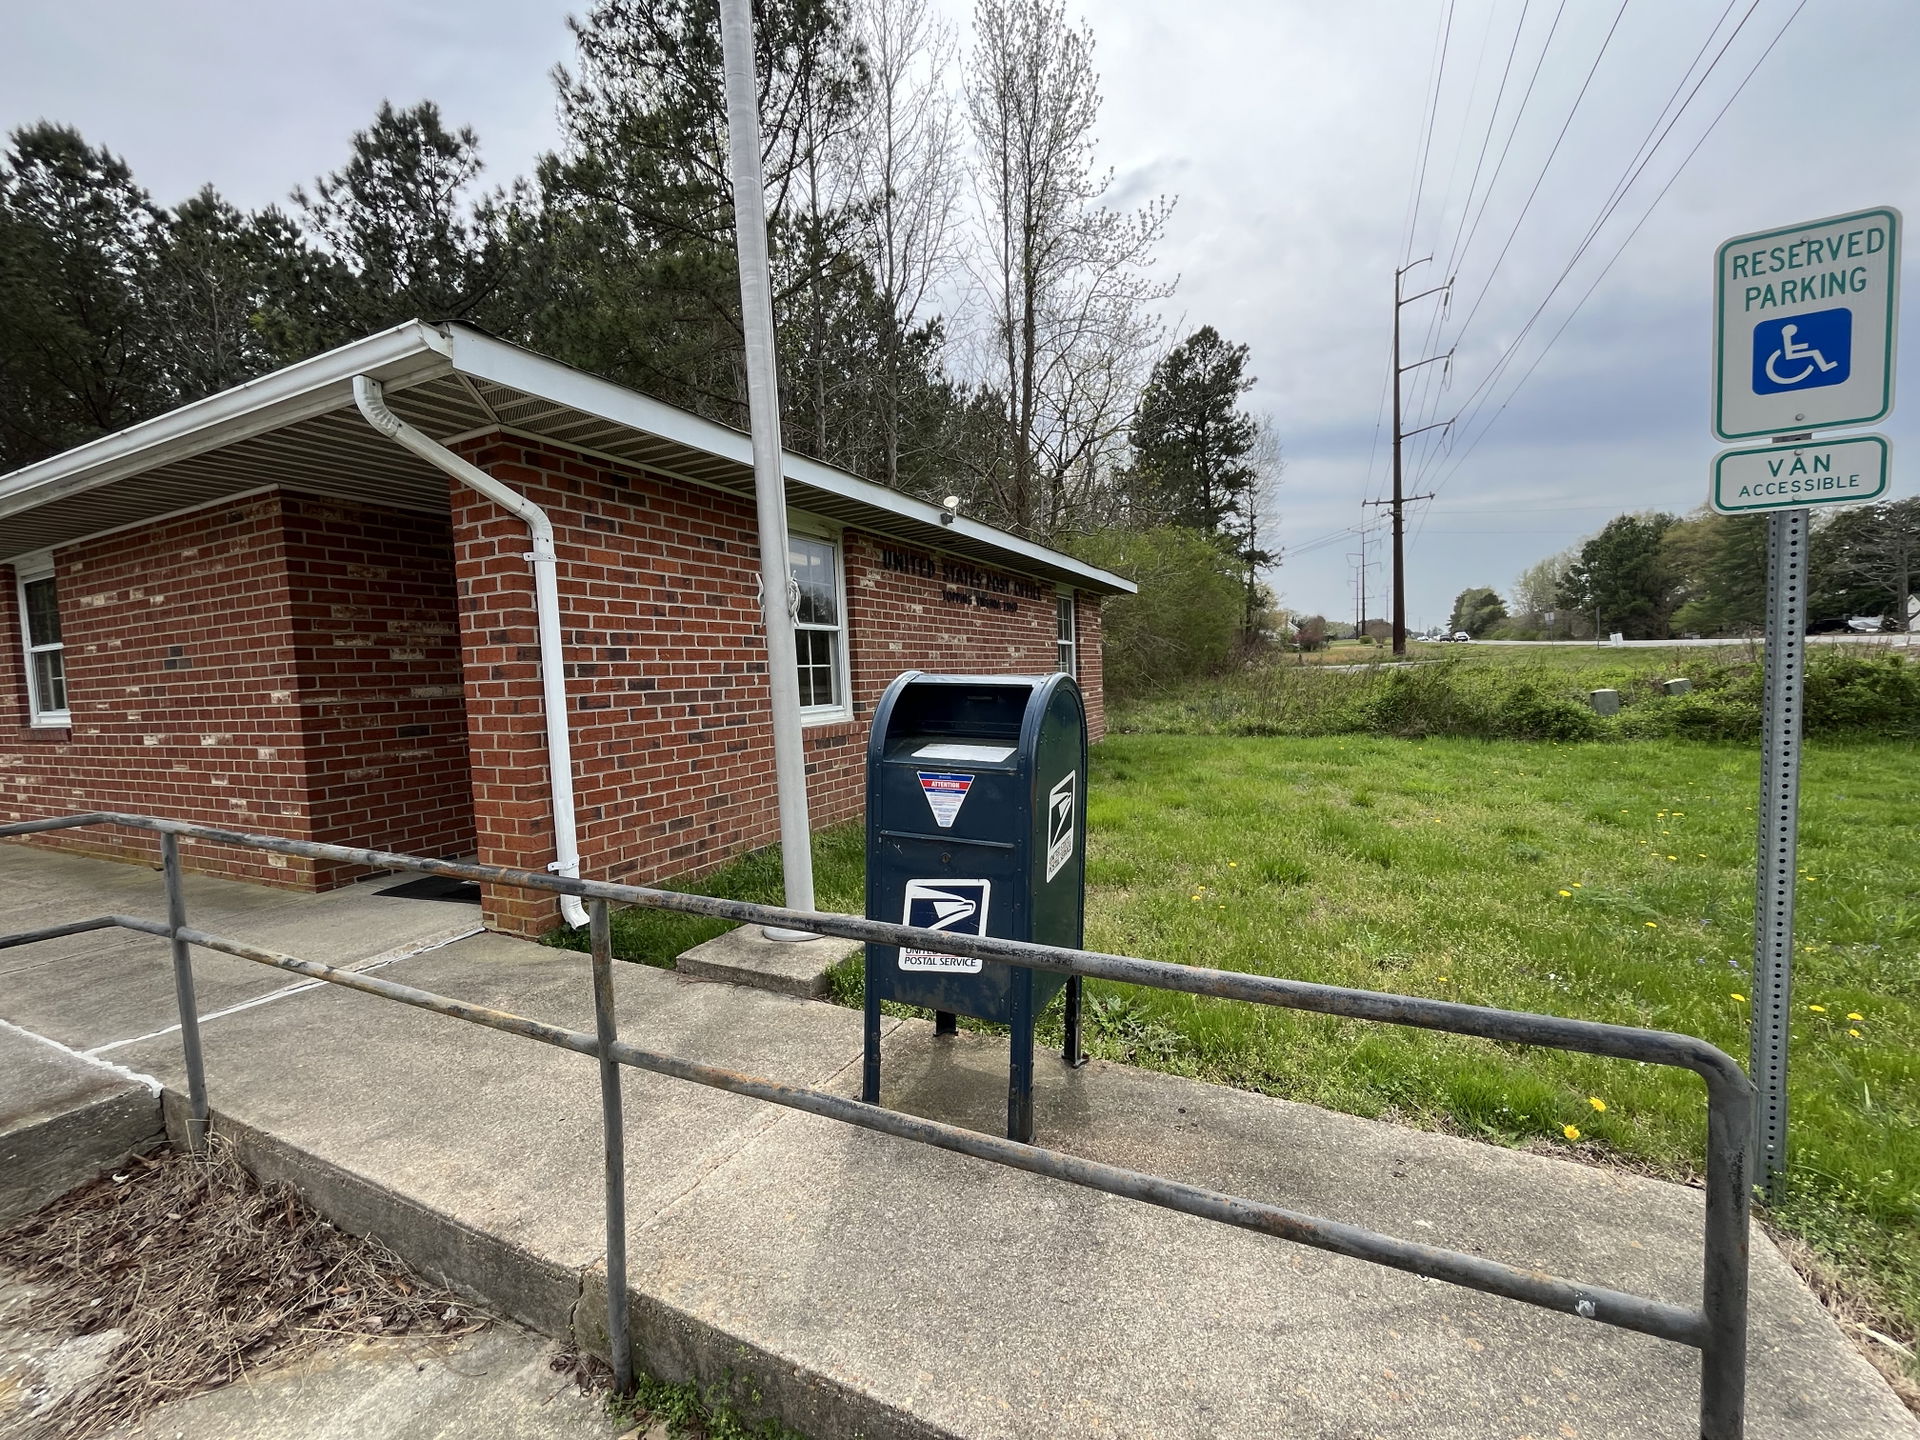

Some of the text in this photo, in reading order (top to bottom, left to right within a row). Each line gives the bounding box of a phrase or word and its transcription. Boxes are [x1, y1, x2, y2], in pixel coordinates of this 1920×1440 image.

[1732, 227, 1886, 280] RESERVED
[1745, 266, 1867, 312] PARKING
[1768, 453, 1831, 478] VAN
[1739, 474, 1860, 498] ACCESSIBLE
[883, 549, 936, 578] UNITED
[943, 561, 981, 588] STATES
[987, 573, 1009, 594] POST
[904, 956, 976, 967] POSTAL SERVICE
